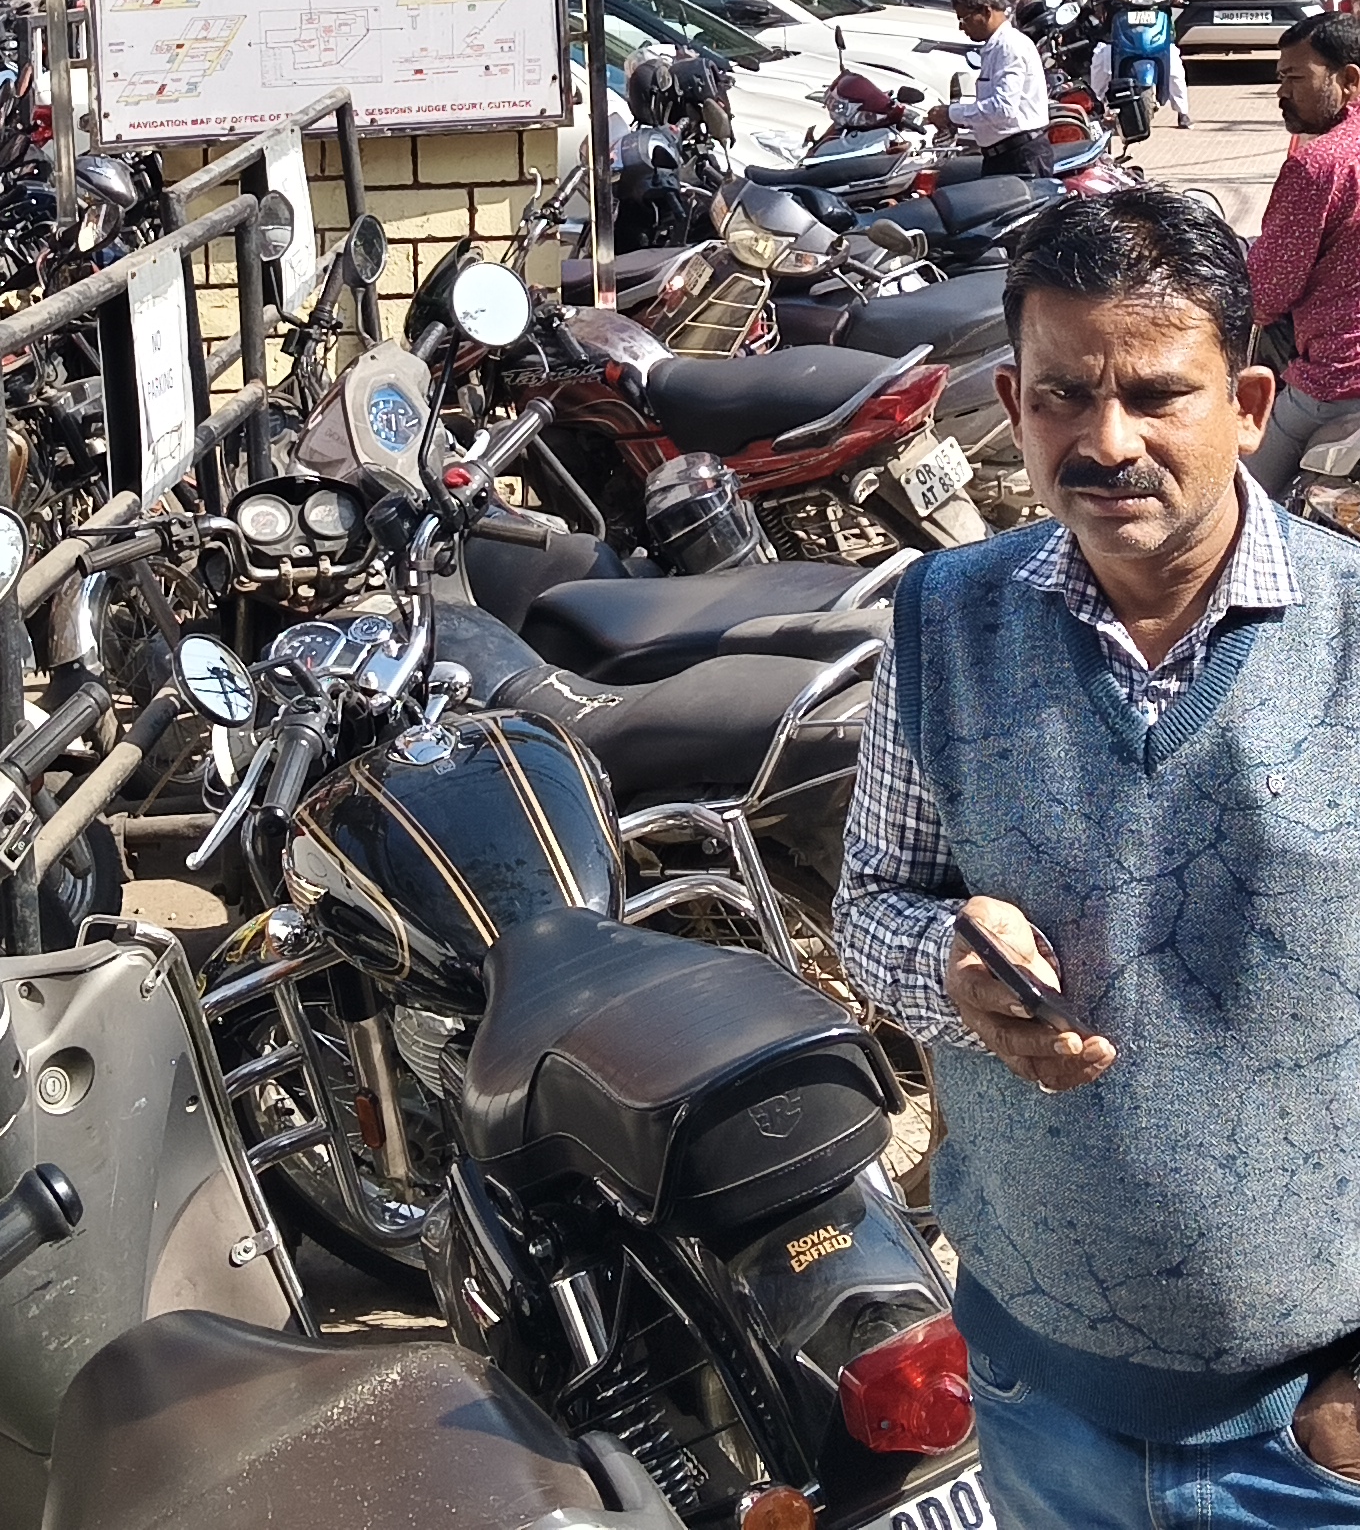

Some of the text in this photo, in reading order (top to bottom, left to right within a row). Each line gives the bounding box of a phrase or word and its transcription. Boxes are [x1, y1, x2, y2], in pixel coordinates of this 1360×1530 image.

[128, 120, 188, 130] NAVIGATION
[231, 114, 266, 123] OFFICE
[268, 113, 283, 122] OF
[364, 105, 413, 116] SESSIONS
[415, 103, 448, 113] JUDGE
[487, 99, 532, 110] CUTTACK
[915, 463, 937, 485] OR
[920, 485, 939, 510] AT
[786, 1225, 840, 1257] ROYAL
[790, 1234, 852, 1273] ENFIELD
